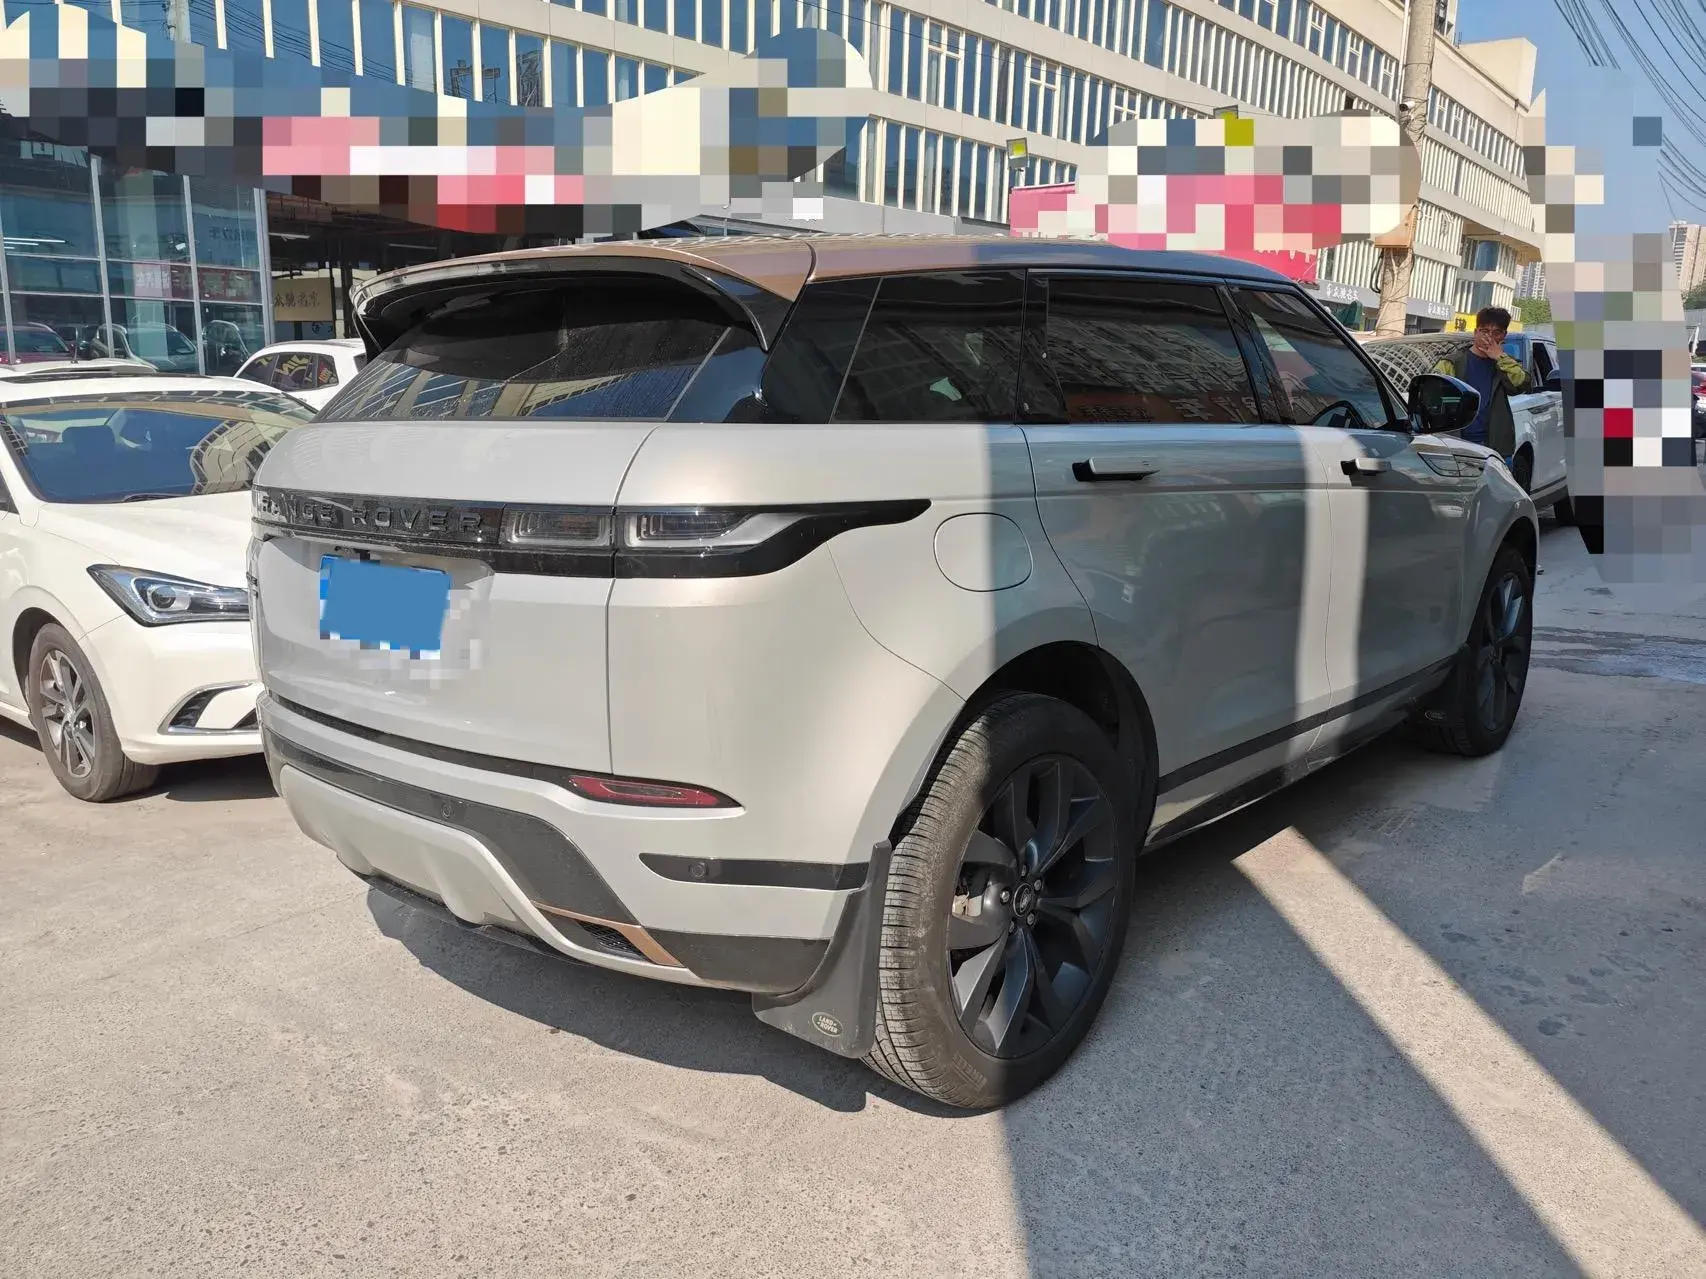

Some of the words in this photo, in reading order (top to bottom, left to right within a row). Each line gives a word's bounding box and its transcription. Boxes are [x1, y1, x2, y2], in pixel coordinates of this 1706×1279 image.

[351, 503, 482, 533] ROVER
[818, 1016, 834, 1026] LAND
[819, 1022, 838, 1034] ROVER
